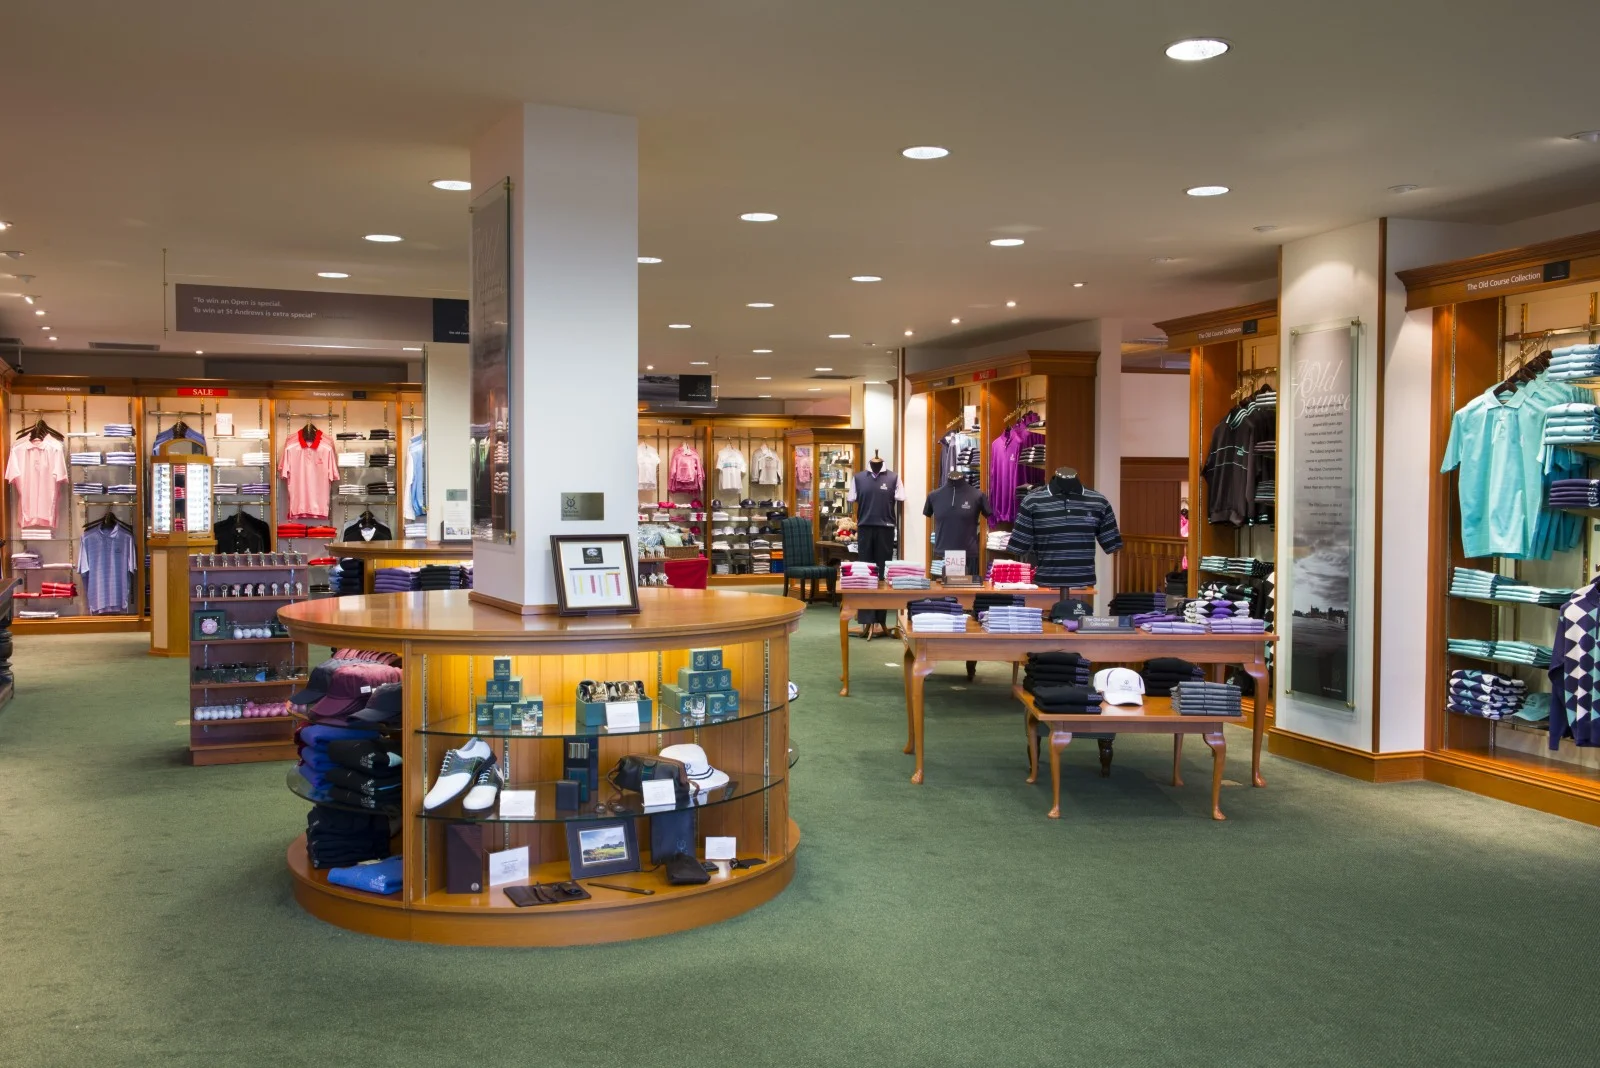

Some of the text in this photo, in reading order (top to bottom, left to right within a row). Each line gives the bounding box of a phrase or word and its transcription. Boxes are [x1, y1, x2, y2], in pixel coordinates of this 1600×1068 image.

[1467, 283, 1478, 291] The
[1478, 281, 1489, 289] Old
[1489, 278, 1510, 288] Course
[1510, 272, 1541, 284] Collection
[230, 298, 249, 306] Open
[234, 308, 264, 316] Andrews
[1223, 327, 1242, 336] Collection
[192, 388, 214, 396] SALE
[945, 557, 966, 567] SALE
